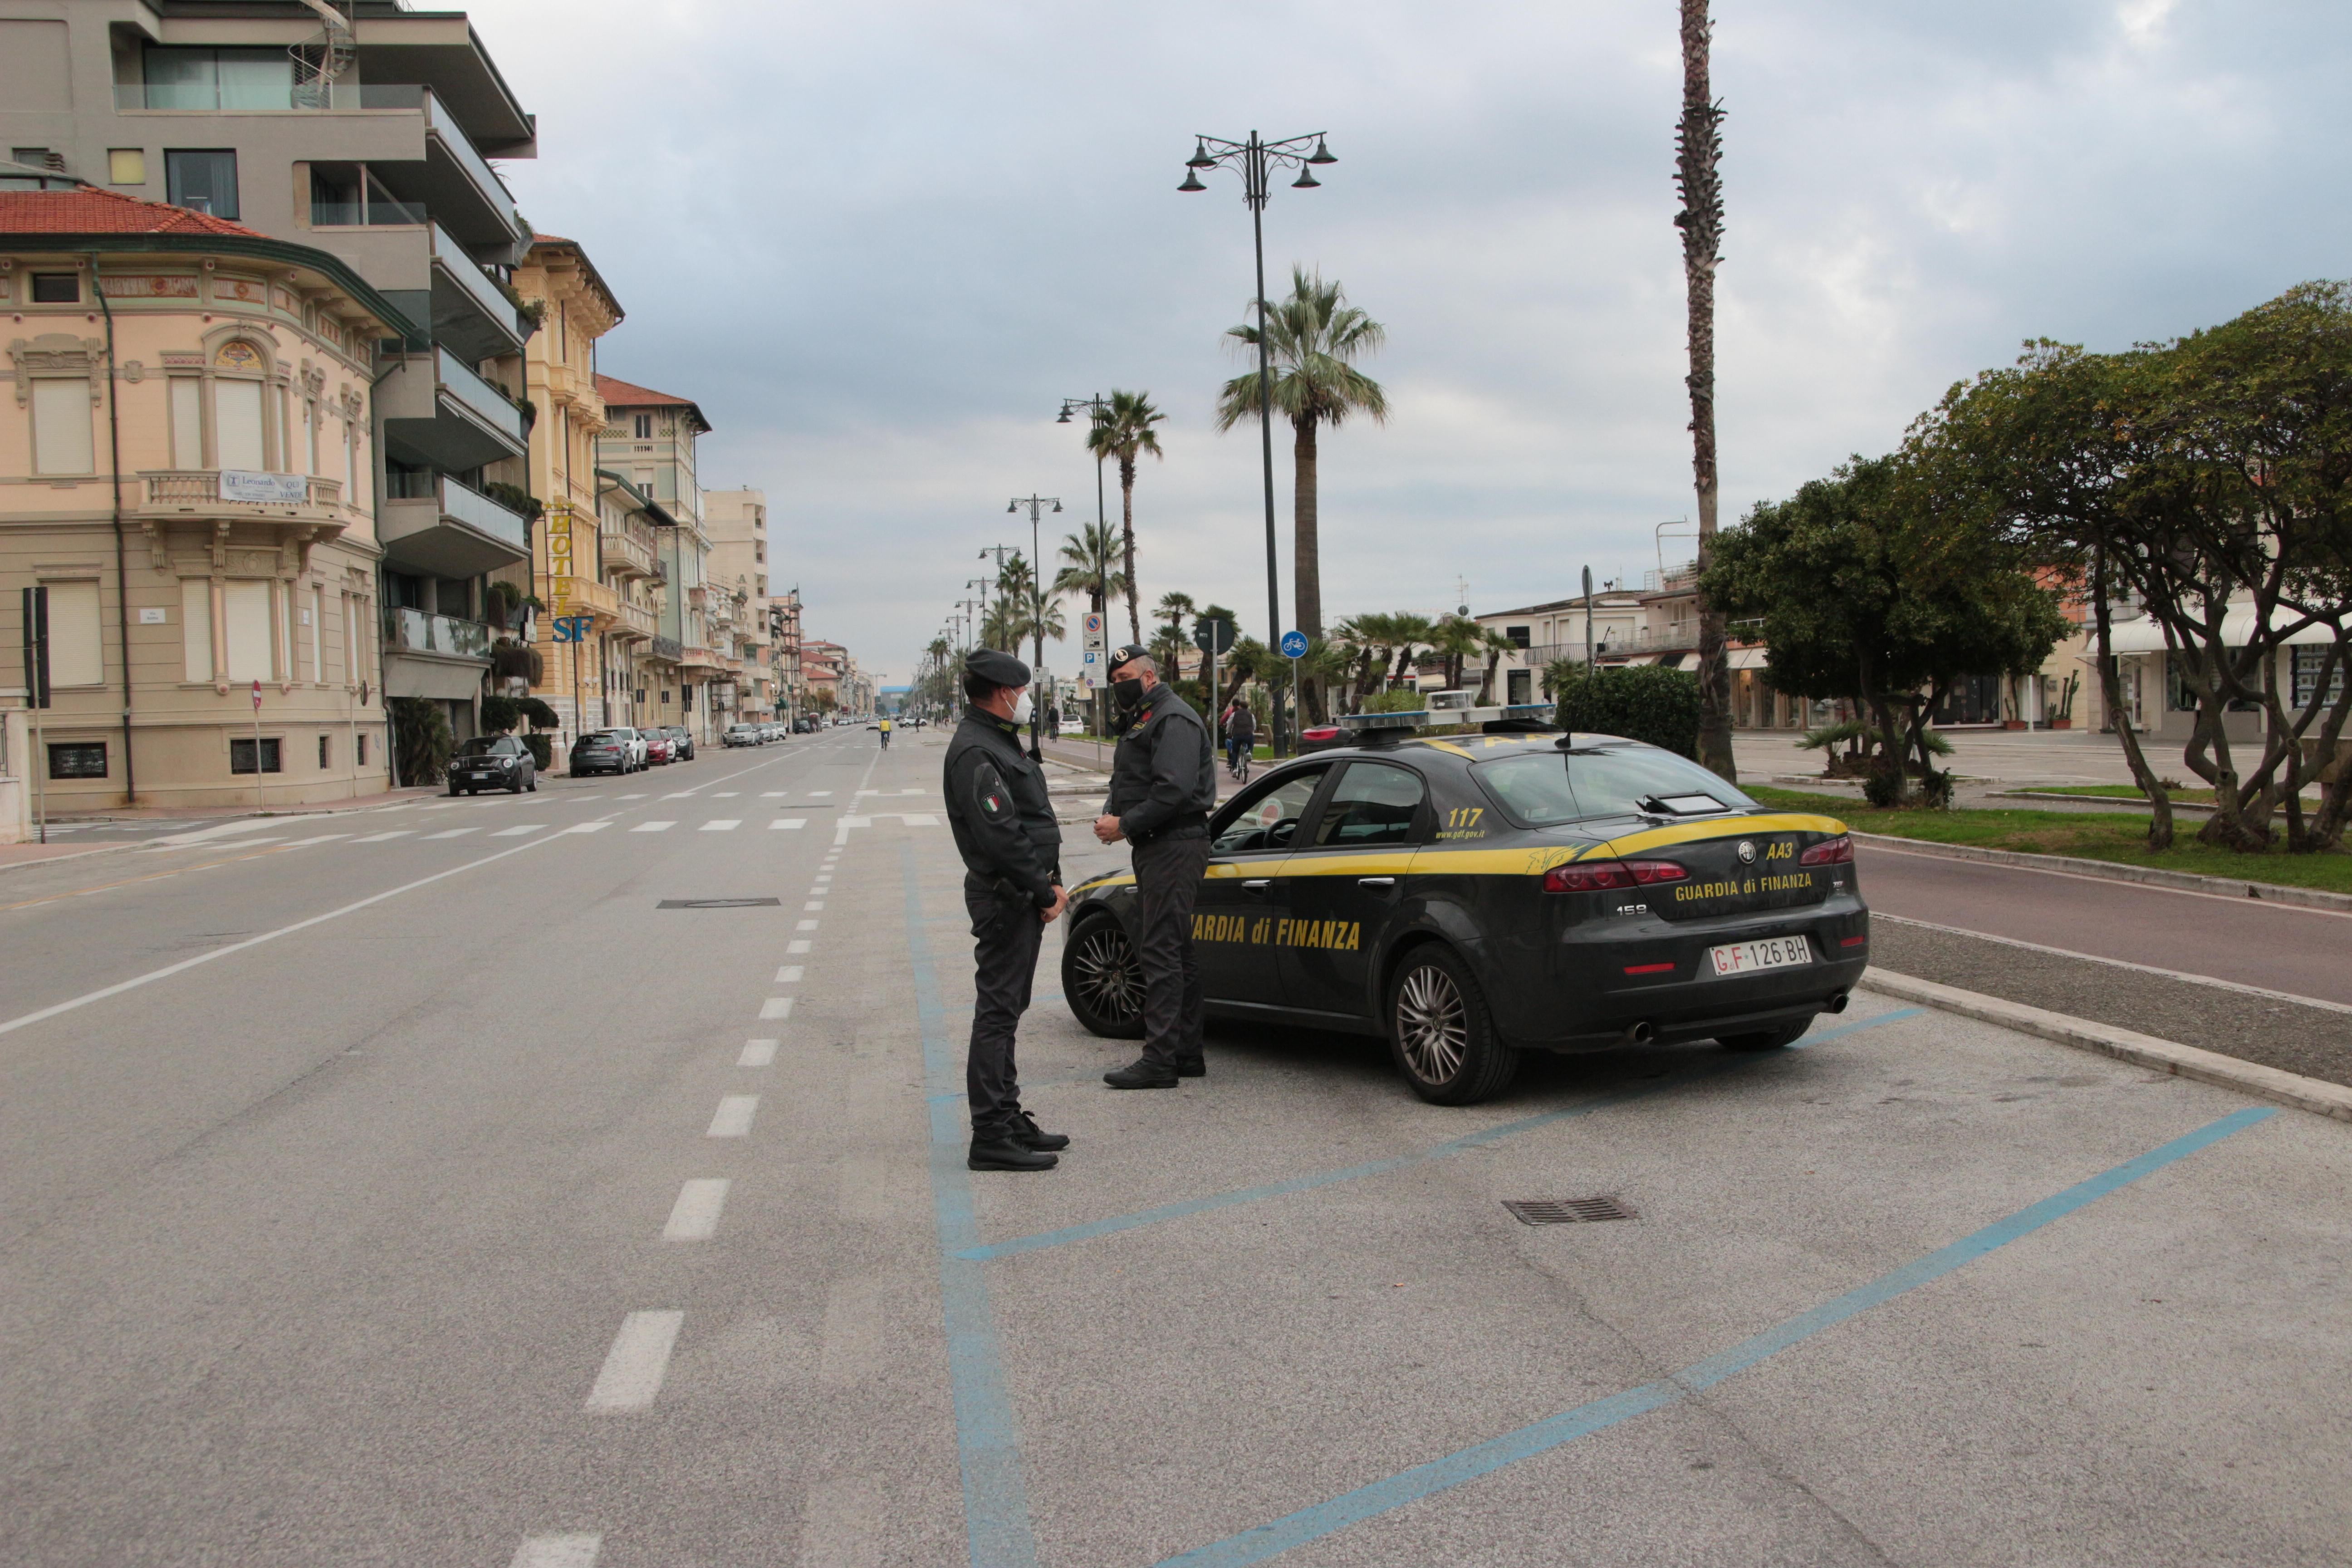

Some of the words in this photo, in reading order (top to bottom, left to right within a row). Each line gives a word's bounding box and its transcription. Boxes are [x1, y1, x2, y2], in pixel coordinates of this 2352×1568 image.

[243, 476, 275, 486] Leonardo
[287, 481, 299, 489] QUI
[549, 515, 573, 615] HOTEL
[553, 616, 593, 642] SF
[1087, 654, 1093, 662] P
[1449, 808, 1484, 827] 117
[1436, 829, 1485, 840] www.gdf.gov.it
[1766, 842, 1793, 860] AA3
[1676, 881, 1739, 901] GUARDIA
[1743, 879, 1756, 894] di
[1761, 873, 1812, 892] FINANZA
[1617, 904, 1647, 916] 159
[1191, 914, 1245, 943] ARDIA
[1251, 918, 1271, 945] di
[1276, 919, 1360, 950] FINANZA
